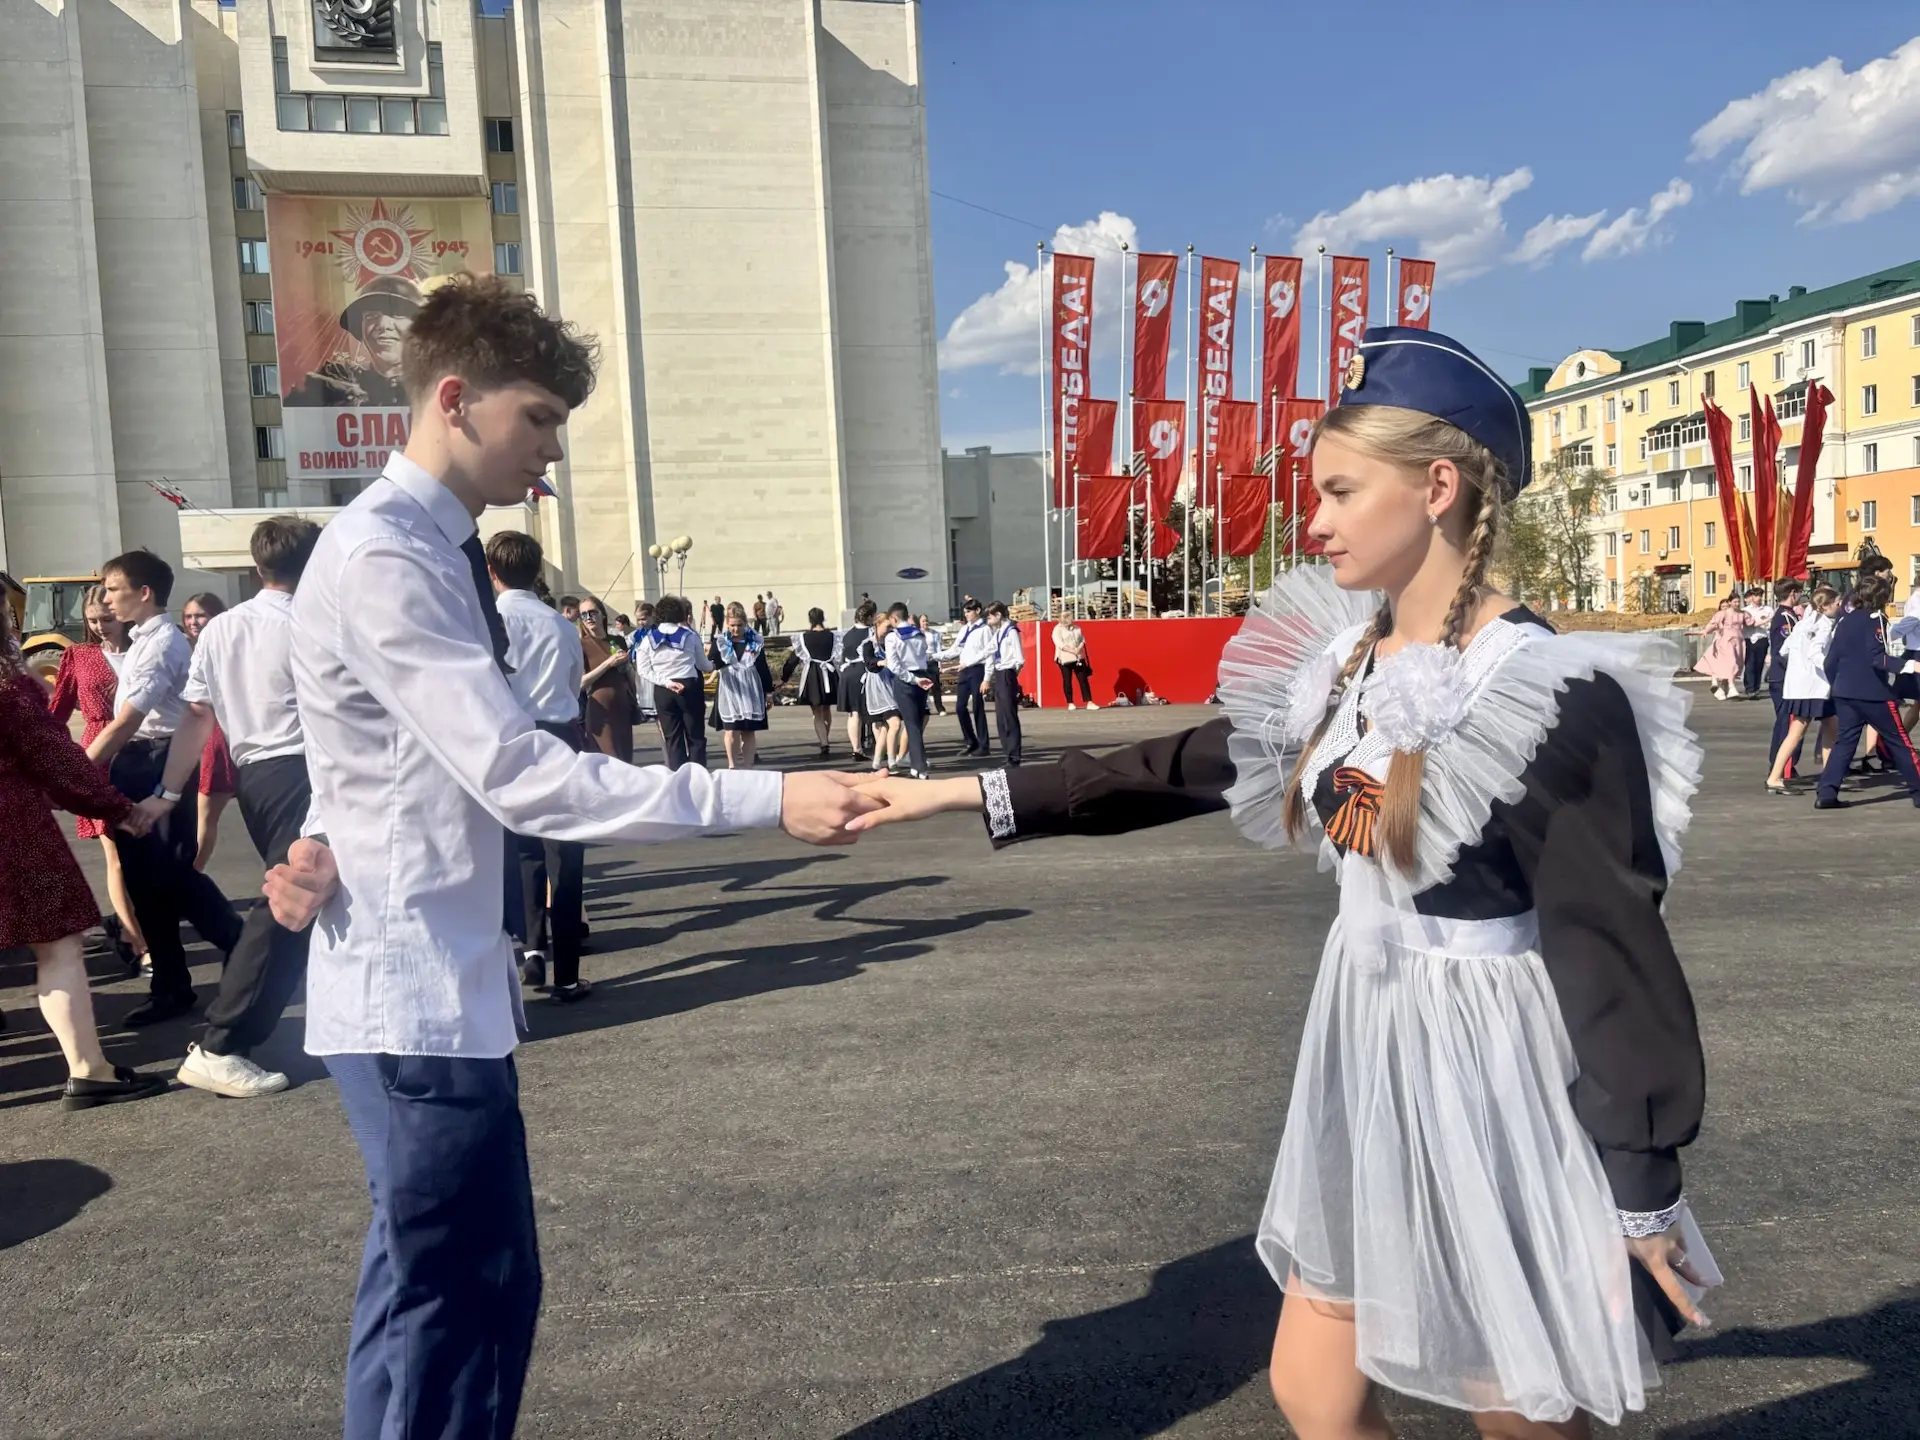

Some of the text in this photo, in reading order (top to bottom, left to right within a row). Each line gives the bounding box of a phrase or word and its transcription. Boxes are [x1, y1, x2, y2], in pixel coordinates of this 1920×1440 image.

[296, 240, 334, 258] 1941
[431, 240, 471, 258] 1945
[1141, 278, 1169, 317] 9
[1269, 280, 1295, 318] 9
[1403, 284, 1430, 321] 9
[336, 412, 412, 447] СЛА
[1149, 419, 1178, 459] 9
[1289, 418, 1314, 458] 9
